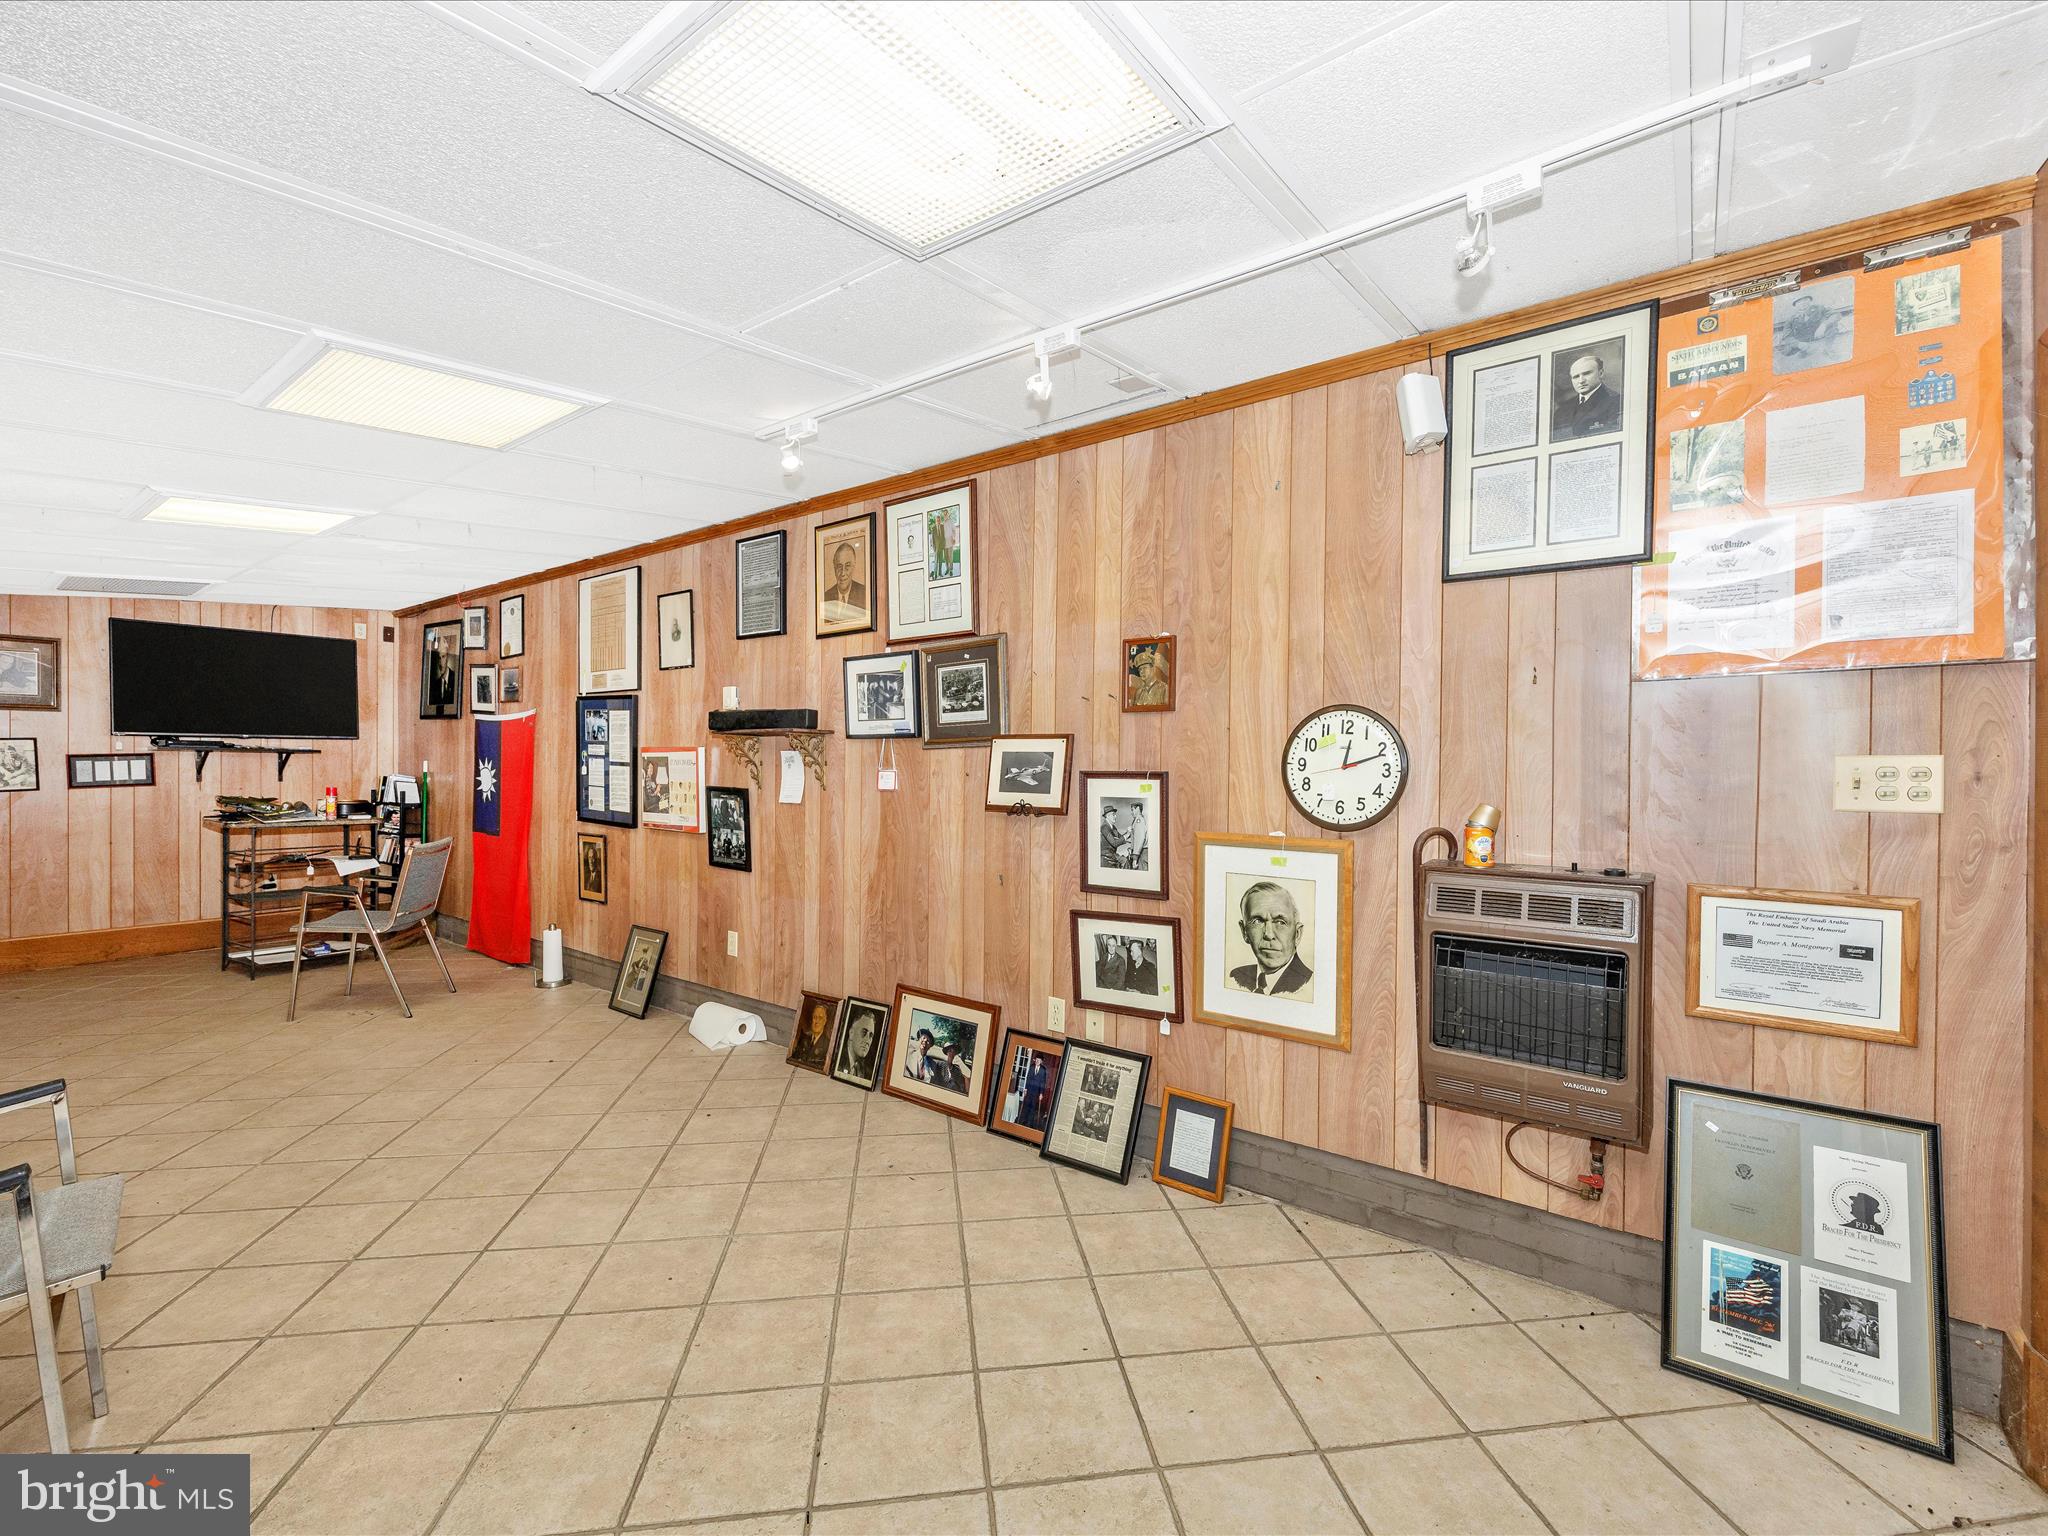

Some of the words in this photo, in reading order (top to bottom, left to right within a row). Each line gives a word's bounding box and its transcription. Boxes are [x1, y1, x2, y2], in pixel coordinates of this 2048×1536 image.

[1671, 348, 1694, 362] SIXTH
[1696, 344, 1720, 356] ARMY
[1720, 340, 1743, 351] NEWS
[1678, 360, 1738, 380] BATAAN
[1322, 724, 1330, 738] 11
[1341, 719, 1354, 734] 12
[1364, 725, 1368, 740] 1
[1304, 738, 1317, 752] 10
[1378, 742, 1387, 757] 2
[1298, 757, 1306, 772] 9
[1382, 762, 1392, 778] 3
[1302, 776, 1310, 791] 8
[1372, 783, 1384, 798] 4
[1335, 800, 1344, 814] 6
[1356, 797, 1366, 811] 5
[1758, 912, 1774, 920] Royal
[1775, 914, 1800, 922] Embassy
[1816, 926, 1847, 934] Memorial
[1756, 938, 1780, 946] Rayner
[1790, 942, 1834, 952] Montgomery
[1562, 1080, 1608, 1096] VANGUARD
[1856, 1222, 1878, 1232] F.D.R.
[1822, 1223, 1843, 1235] BRACED
[1844, 1228, 1855, 1238] FOR
[1856, 1231, 1868, 1240] THE
[1870, 1234, 1902, 1249] PRESIDENCY
[1743, 1336, 1772, 1349] REMEMBER
[1858, 1370, 1895, 1386] PRESIDENCY
